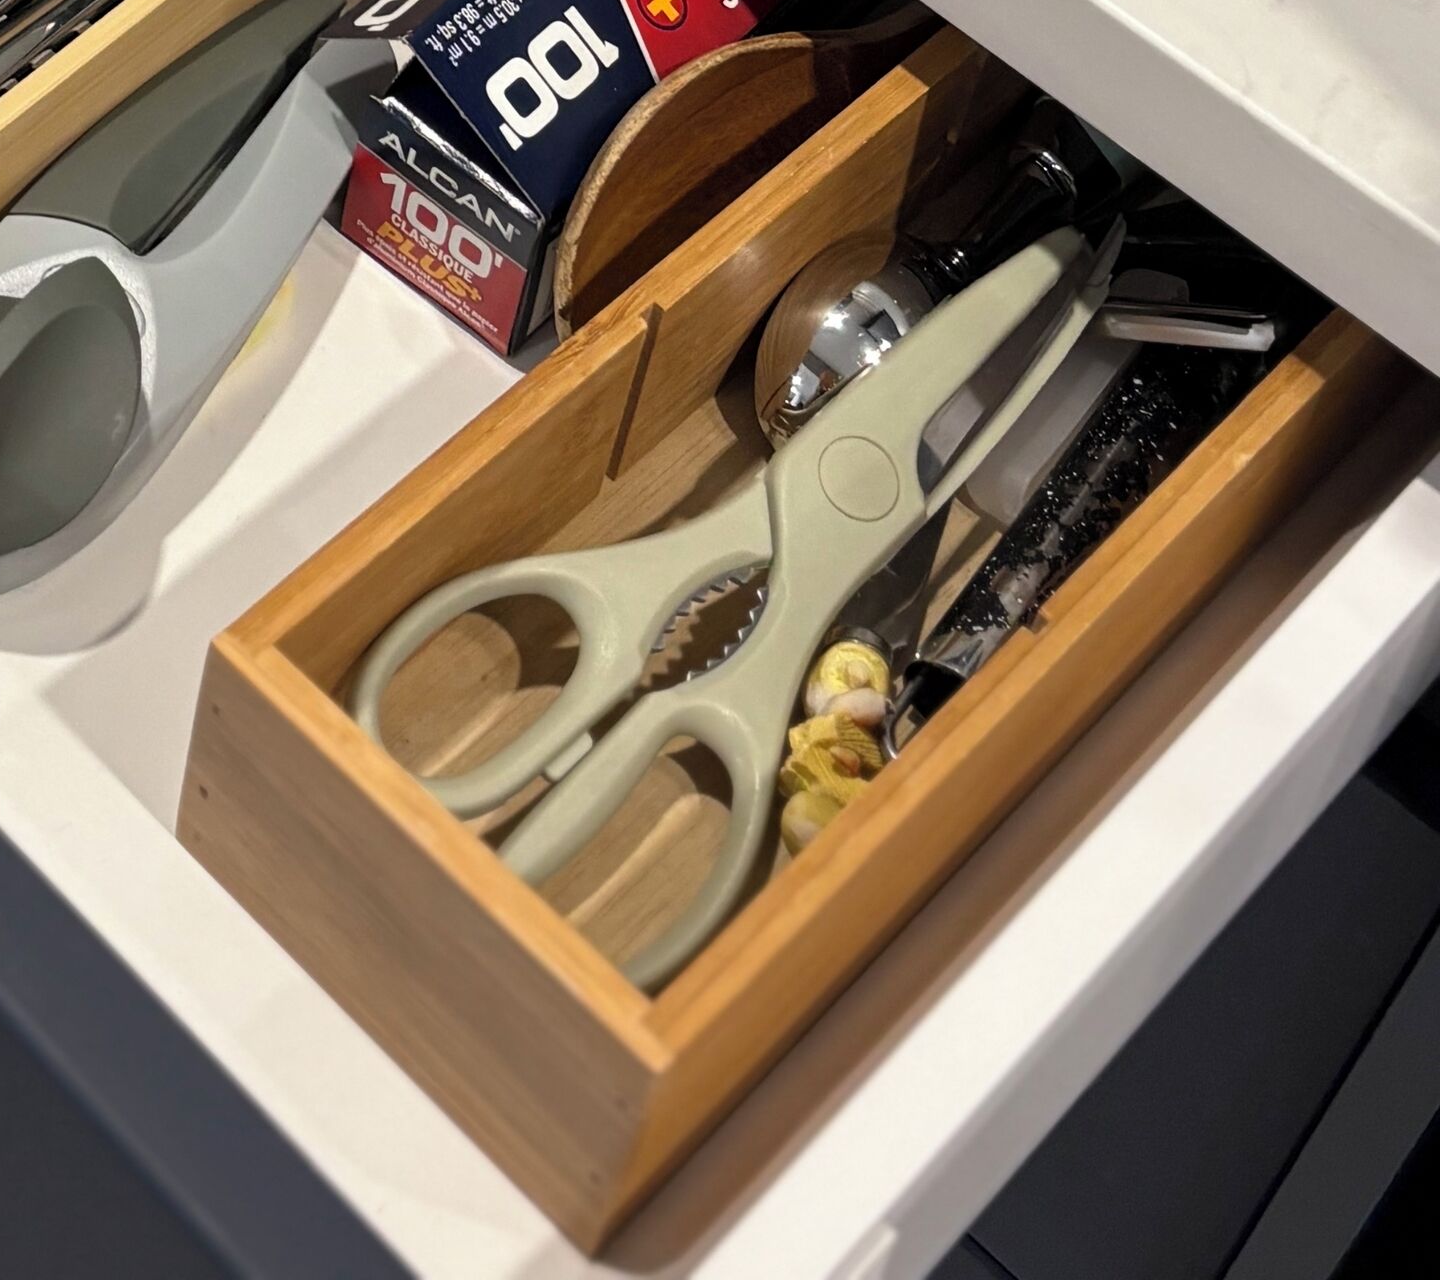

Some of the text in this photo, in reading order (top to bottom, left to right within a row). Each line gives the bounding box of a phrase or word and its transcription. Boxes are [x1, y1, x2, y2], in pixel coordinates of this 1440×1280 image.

[453, 3, 480, 31] 98.3
[482, 14, 497, 30] m
[436, 20, 457, 40] sq.
[460, 28, 481, 54] 9.1
[424, 34, 444, 53] ft.
[391, 213, 474, 284] CLASSIQUE
